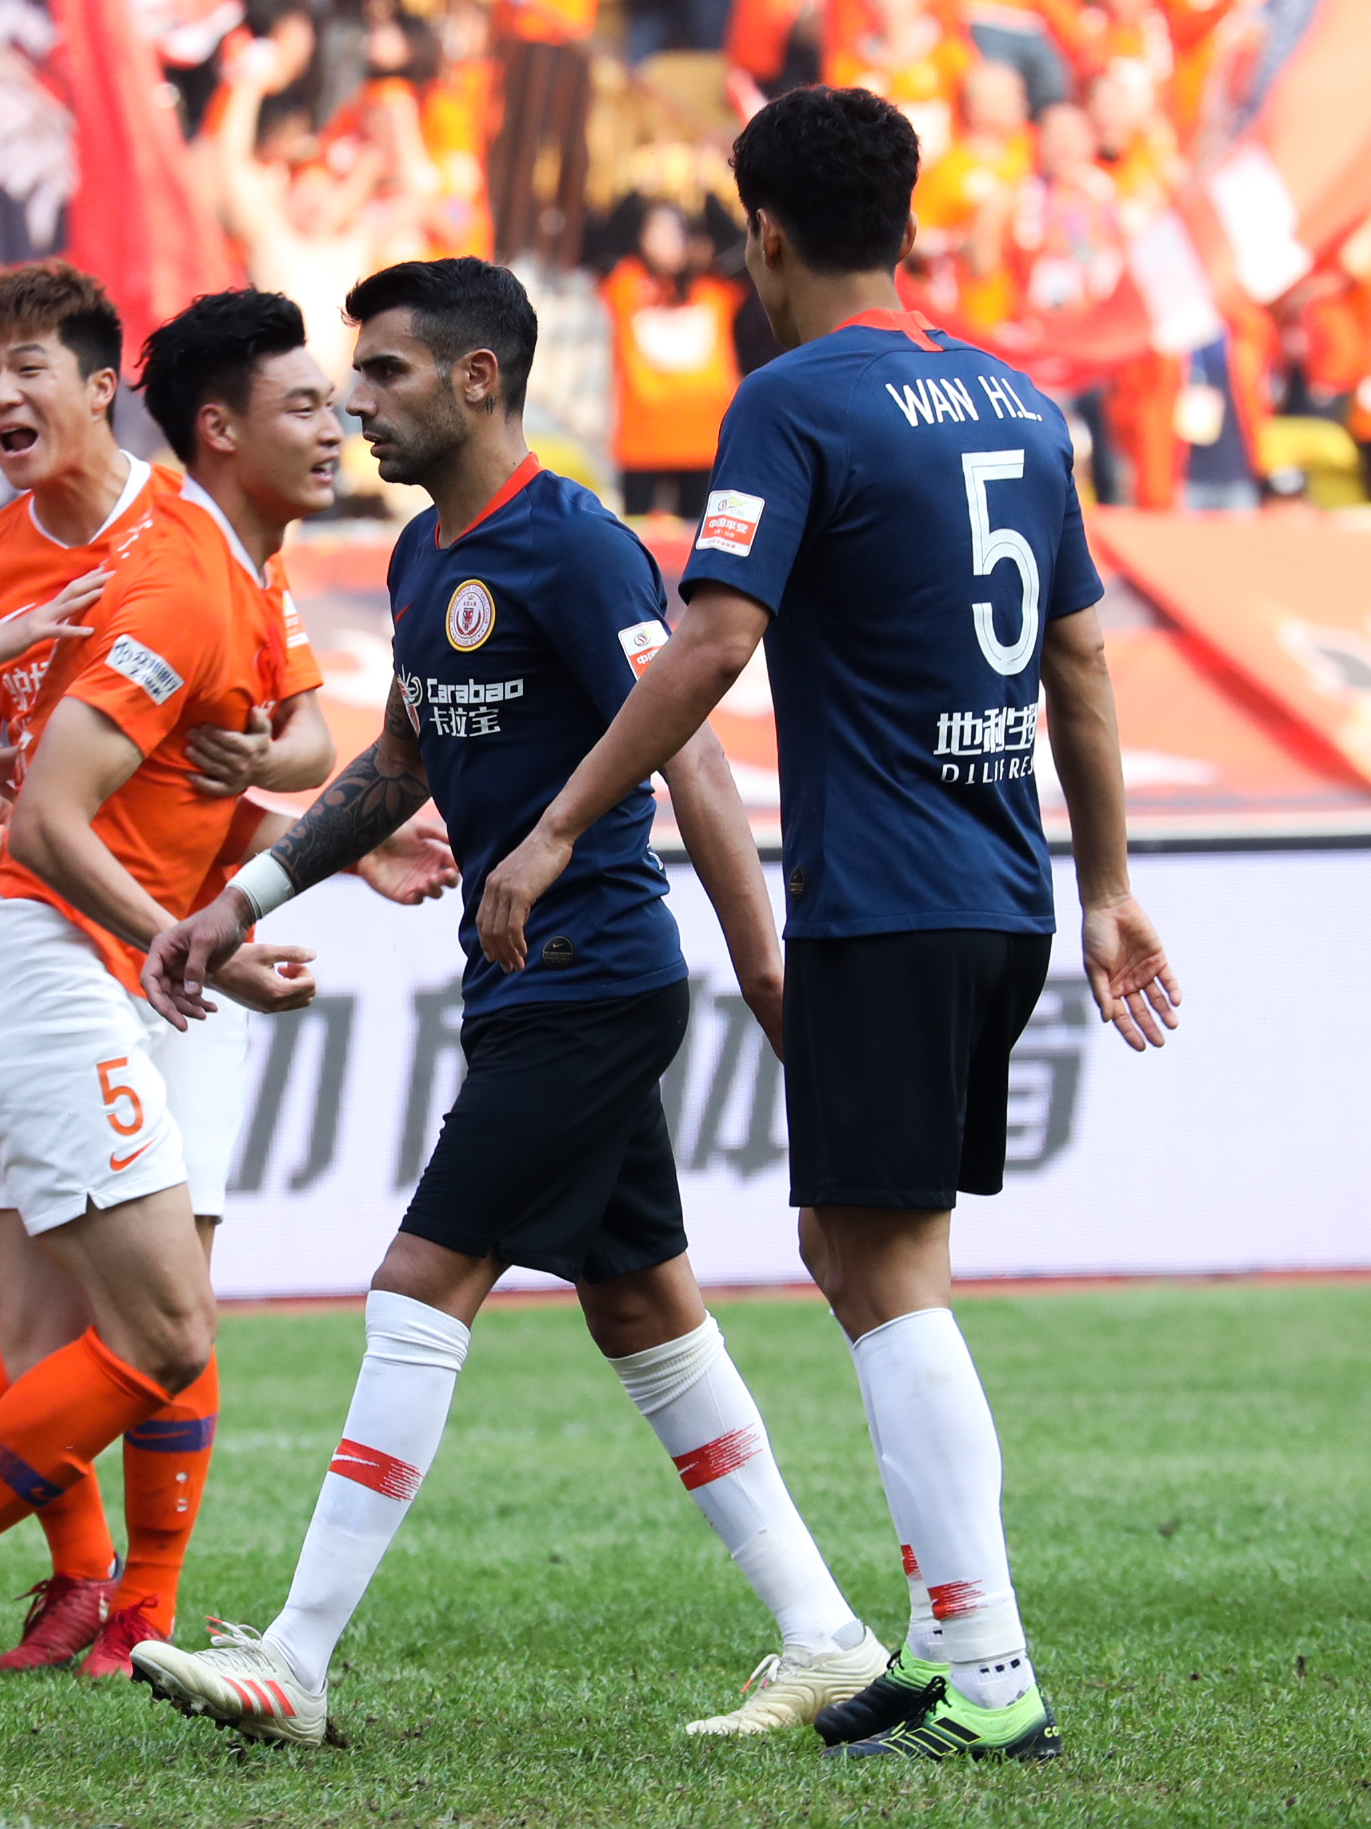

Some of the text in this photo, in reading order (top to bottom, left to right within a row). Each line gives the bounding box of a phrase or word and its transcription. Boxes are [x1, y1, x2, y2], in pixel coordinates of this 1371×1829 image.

[884, 375, 1043, 427] WAN H.L.
[961, 448, 1040, 676] 5
[427, 678, 524, 704] Carabao
[429, 706, 501, 738] 卡拉宝
[96, 1056, 143, 1137] 5
